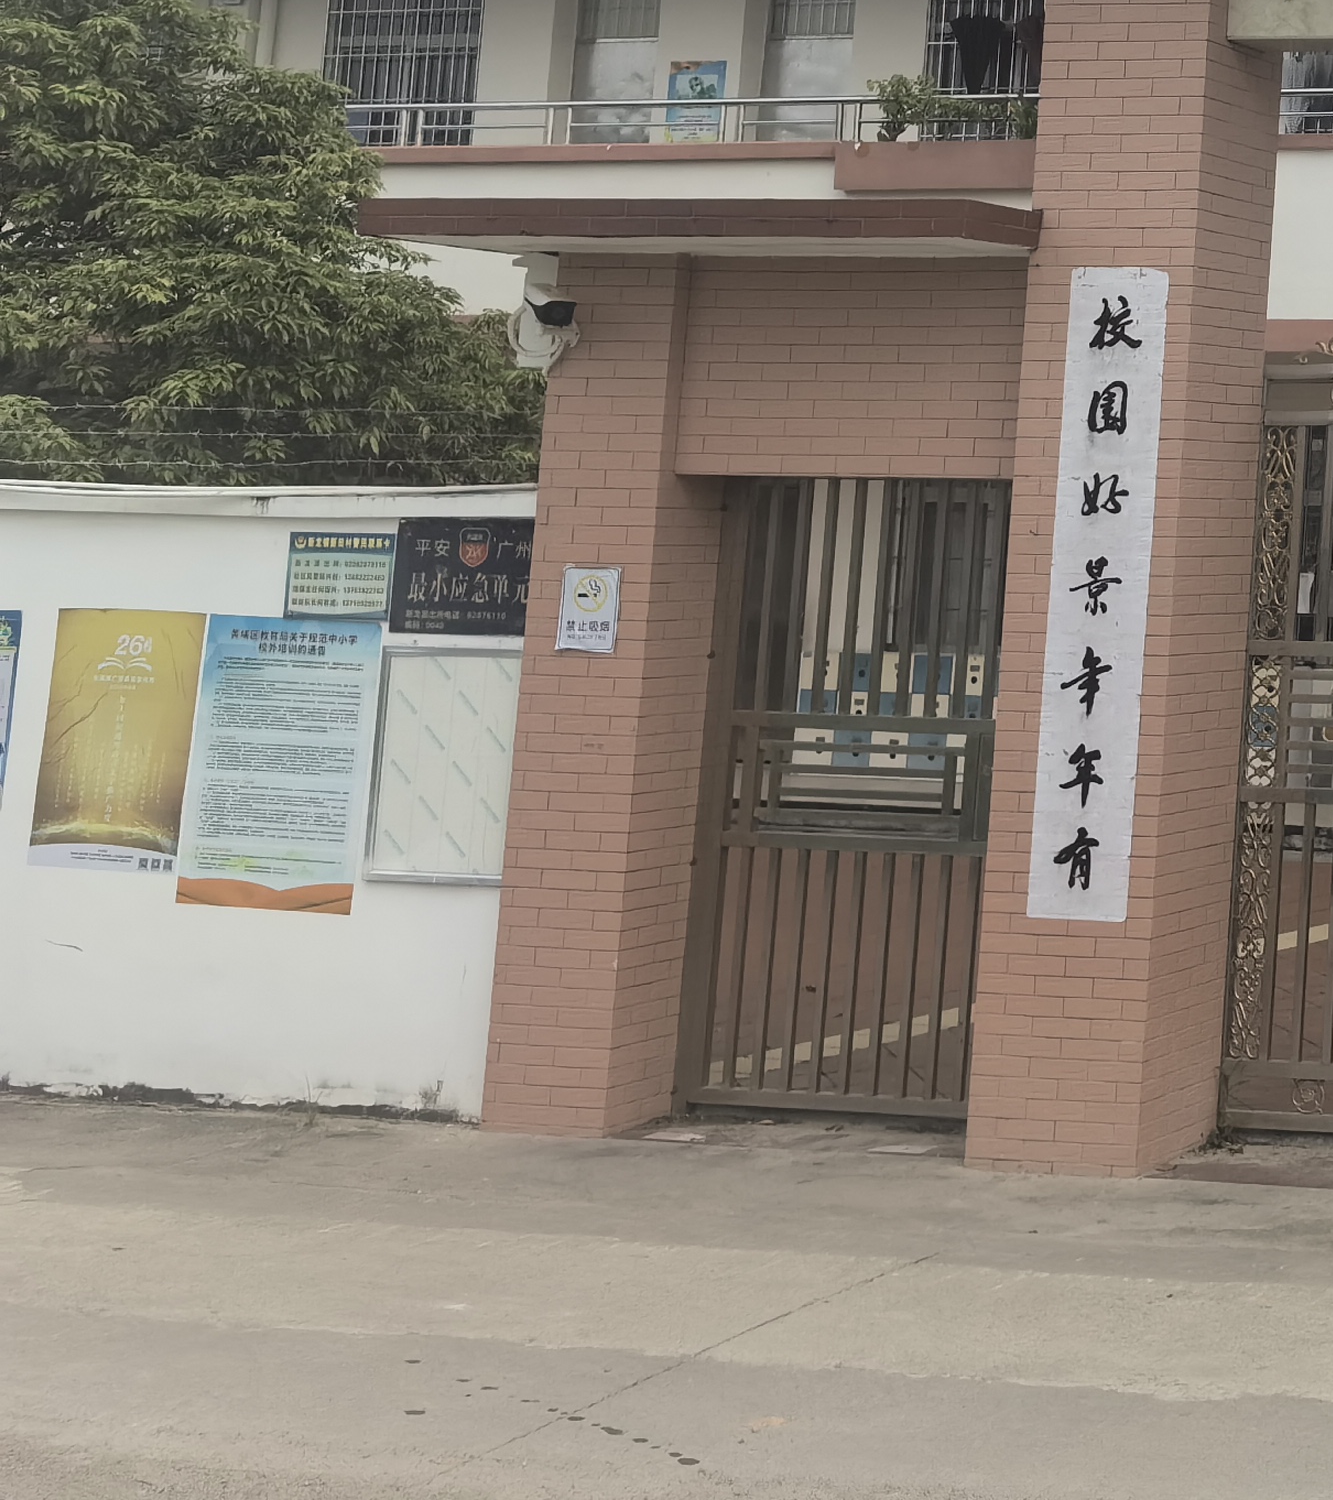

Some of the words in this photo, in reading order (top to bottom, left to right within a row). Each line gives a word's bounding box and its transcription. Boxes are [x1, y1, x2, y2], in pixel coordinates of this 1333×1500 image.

[415, 539, 451, 557] 平安
[496, 540, 531, 559] 广州
[407, 572, 530, 605] 最小应急单元
[566, 620, 610, 632] 禁止吸烟
